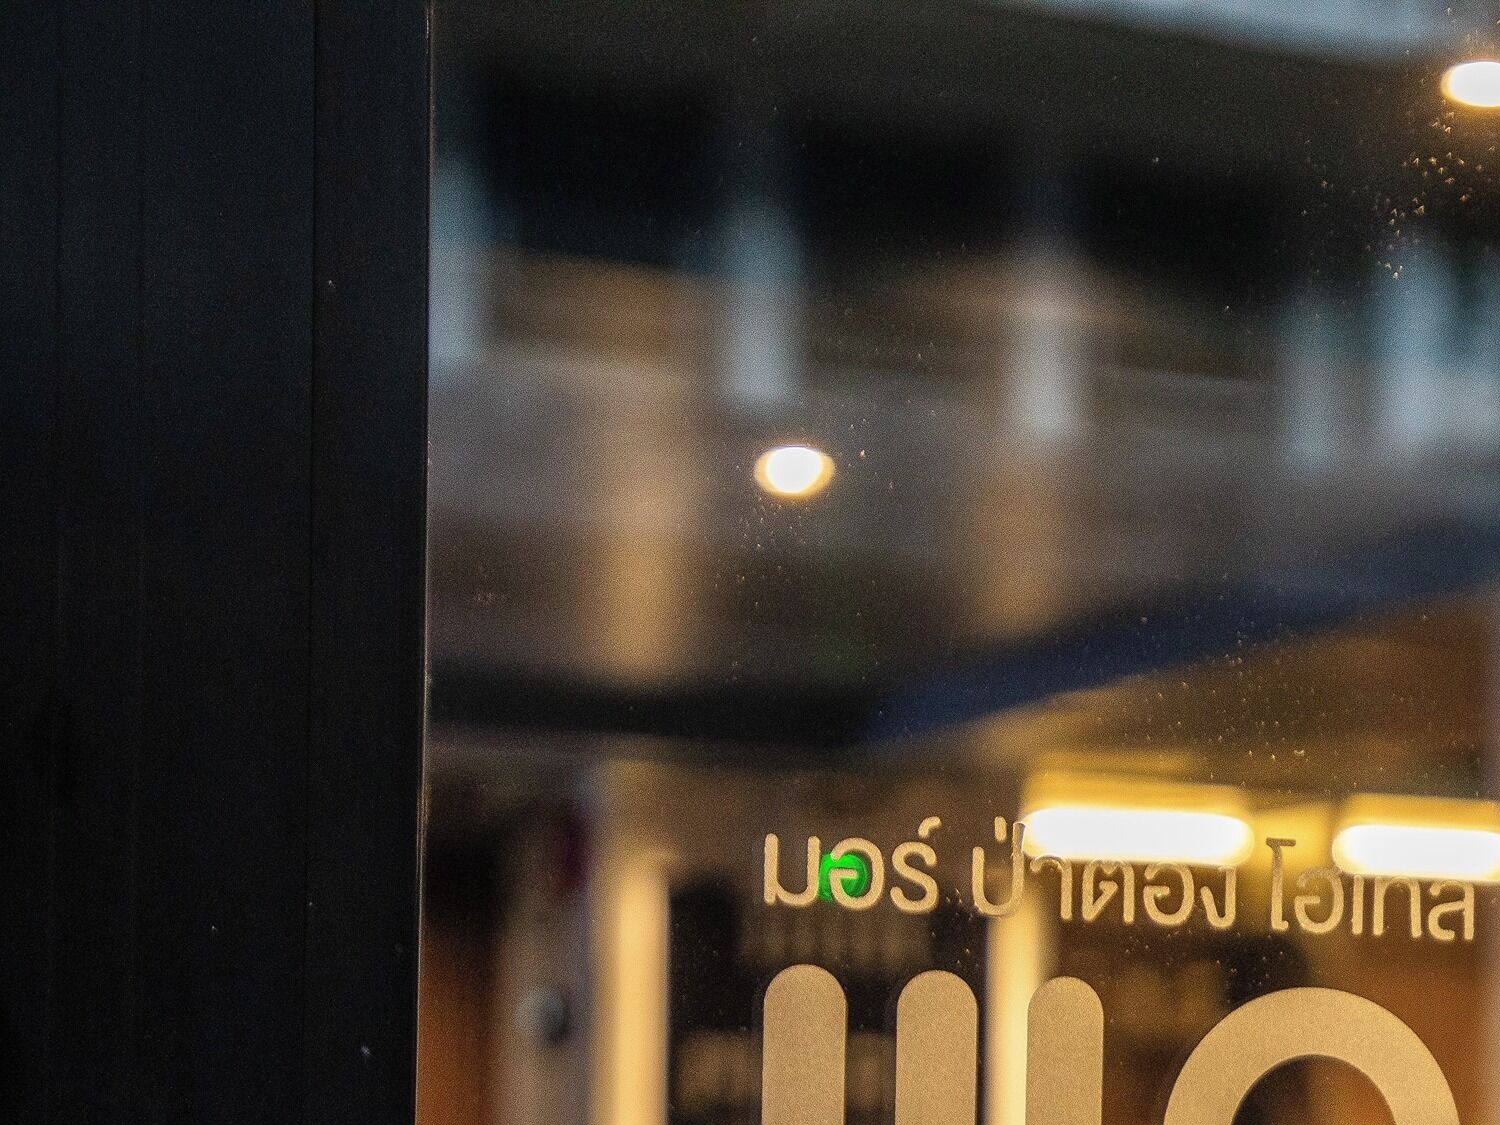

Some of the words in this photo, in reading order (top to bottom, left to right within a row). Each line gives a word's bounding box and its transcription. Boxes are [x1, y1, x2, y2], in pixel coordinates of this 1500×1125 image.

[763, 815, 943, 915] มอร์
[971, 815, 1237, 930] ป่าตอง
